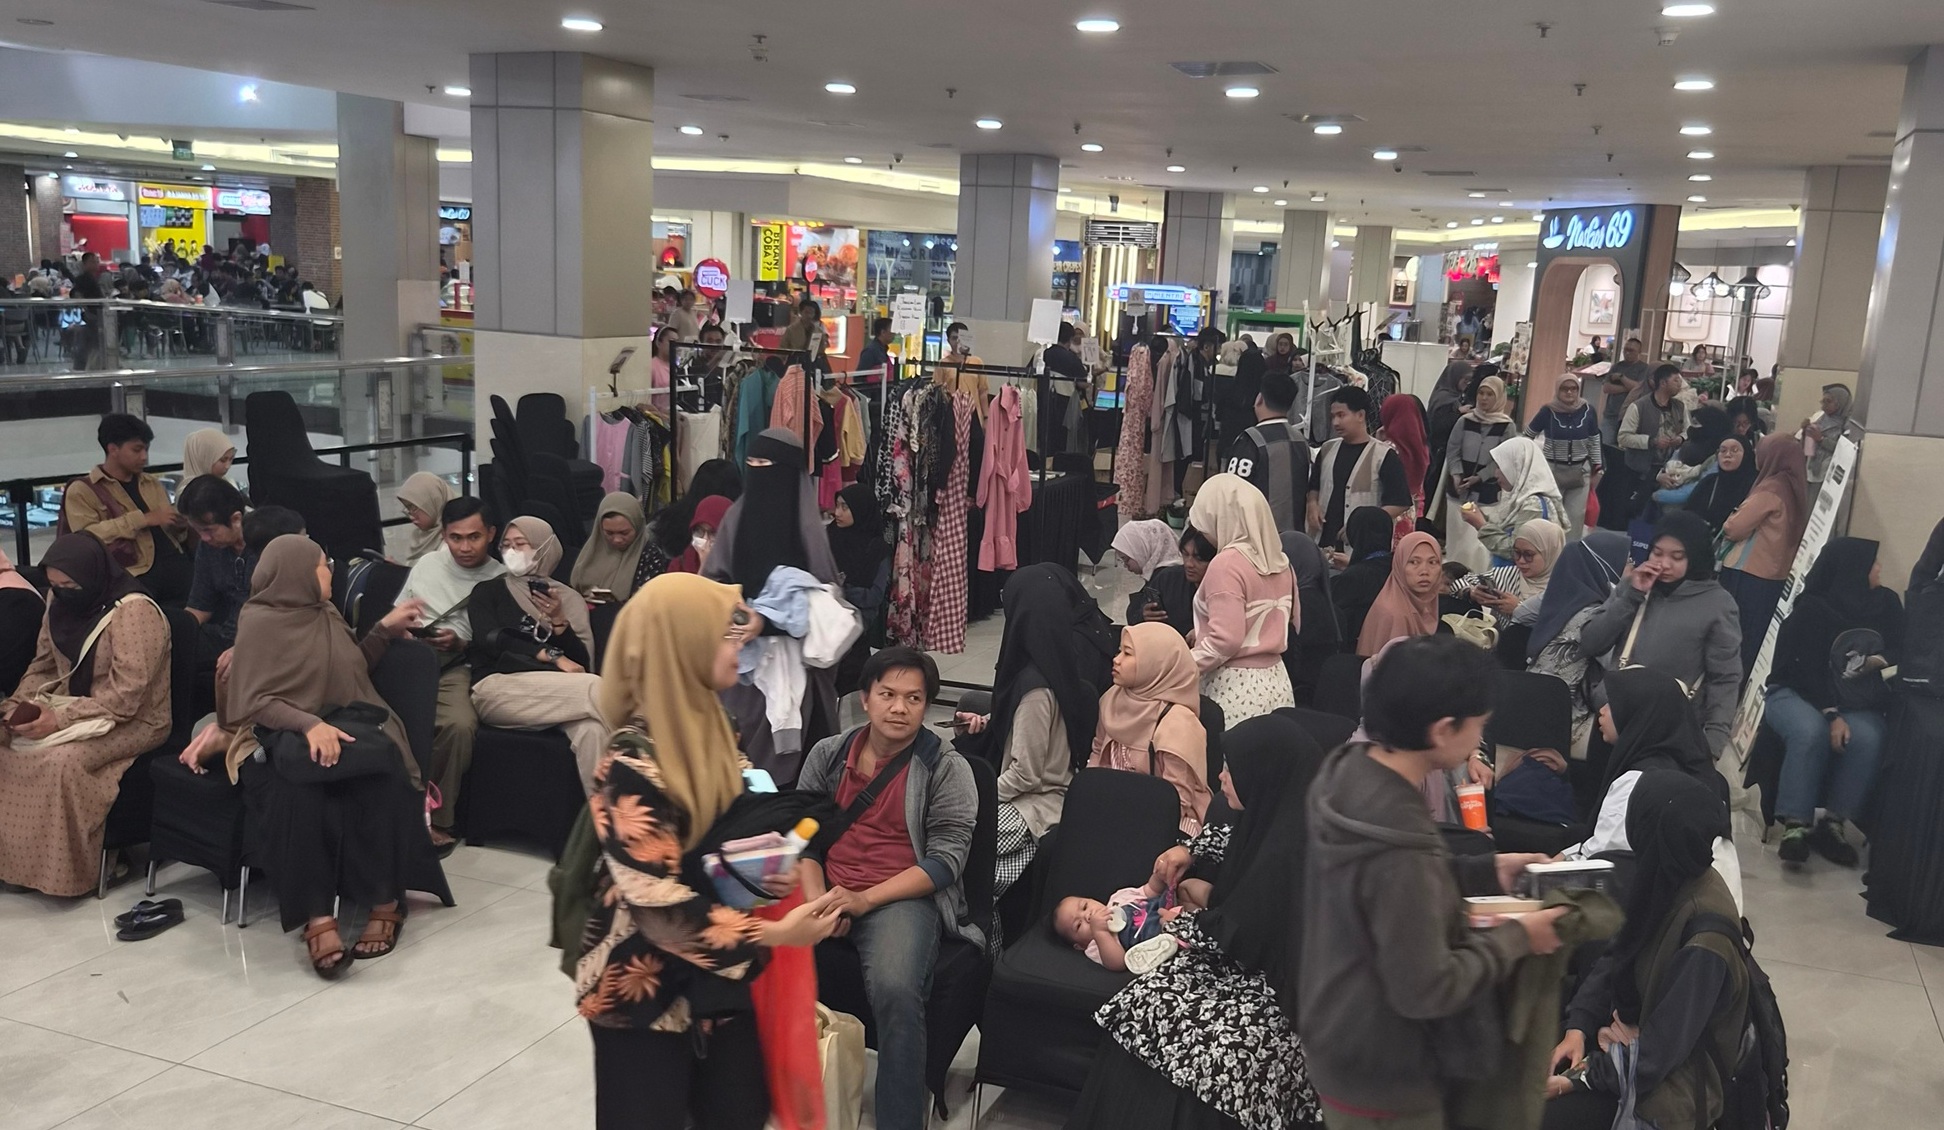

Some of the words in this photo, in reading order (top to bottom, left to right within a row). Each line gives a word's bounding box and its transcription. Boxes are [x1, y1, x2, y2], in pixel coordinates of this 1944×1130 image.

[763, 228, 773, 258] COBA
[1605, 209, 1632, 248] 69
[1227, 456, 1254, 478] 88
